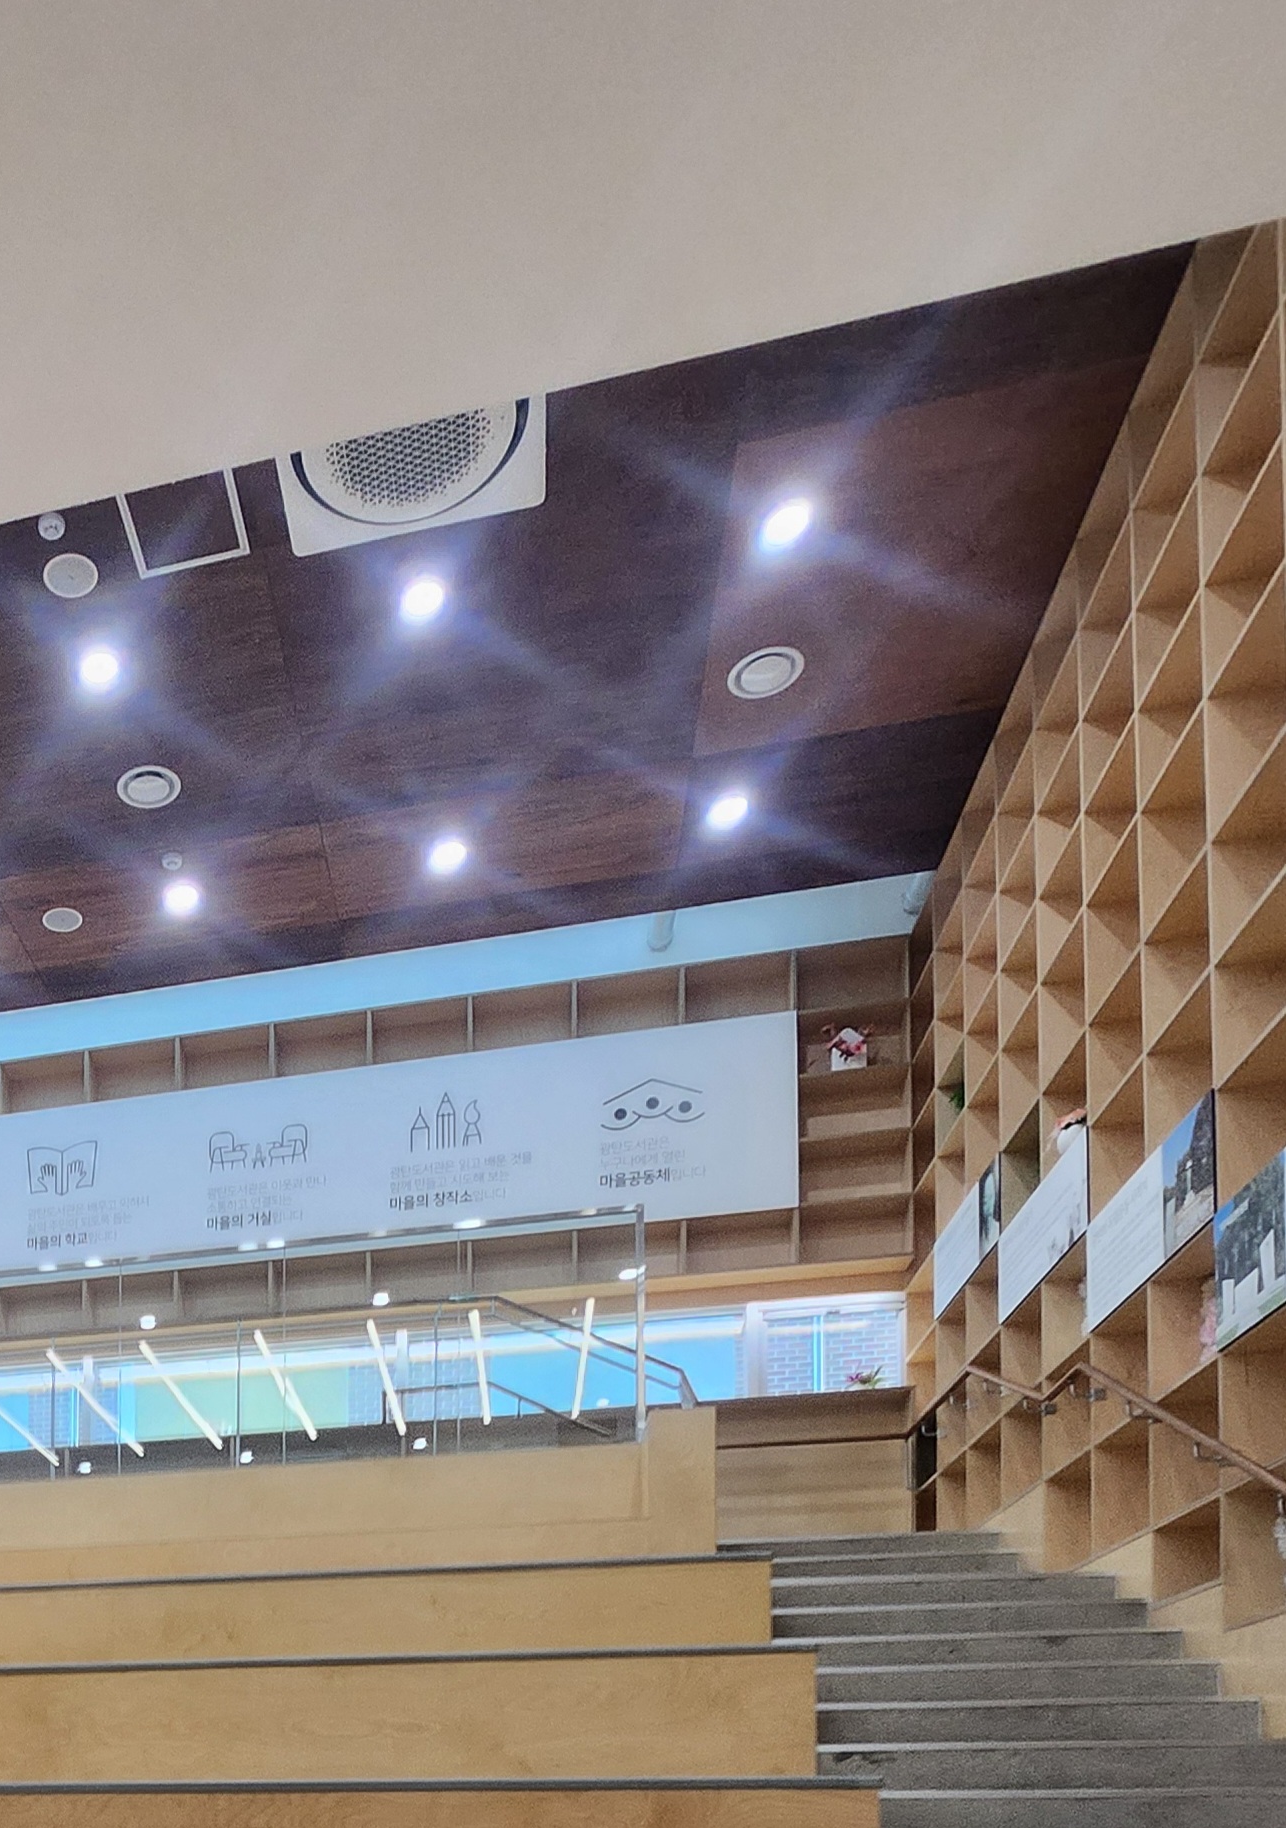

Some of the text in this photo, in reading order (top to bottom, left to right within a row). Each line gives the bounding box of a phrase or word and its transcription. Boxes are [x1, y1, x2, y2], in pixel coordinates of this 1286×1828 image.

[389, 1193, 428, 1211] 마을의
[206, 1213, 243, 1231] 마을의
[27, 1234, 61, 1251] 마을의
